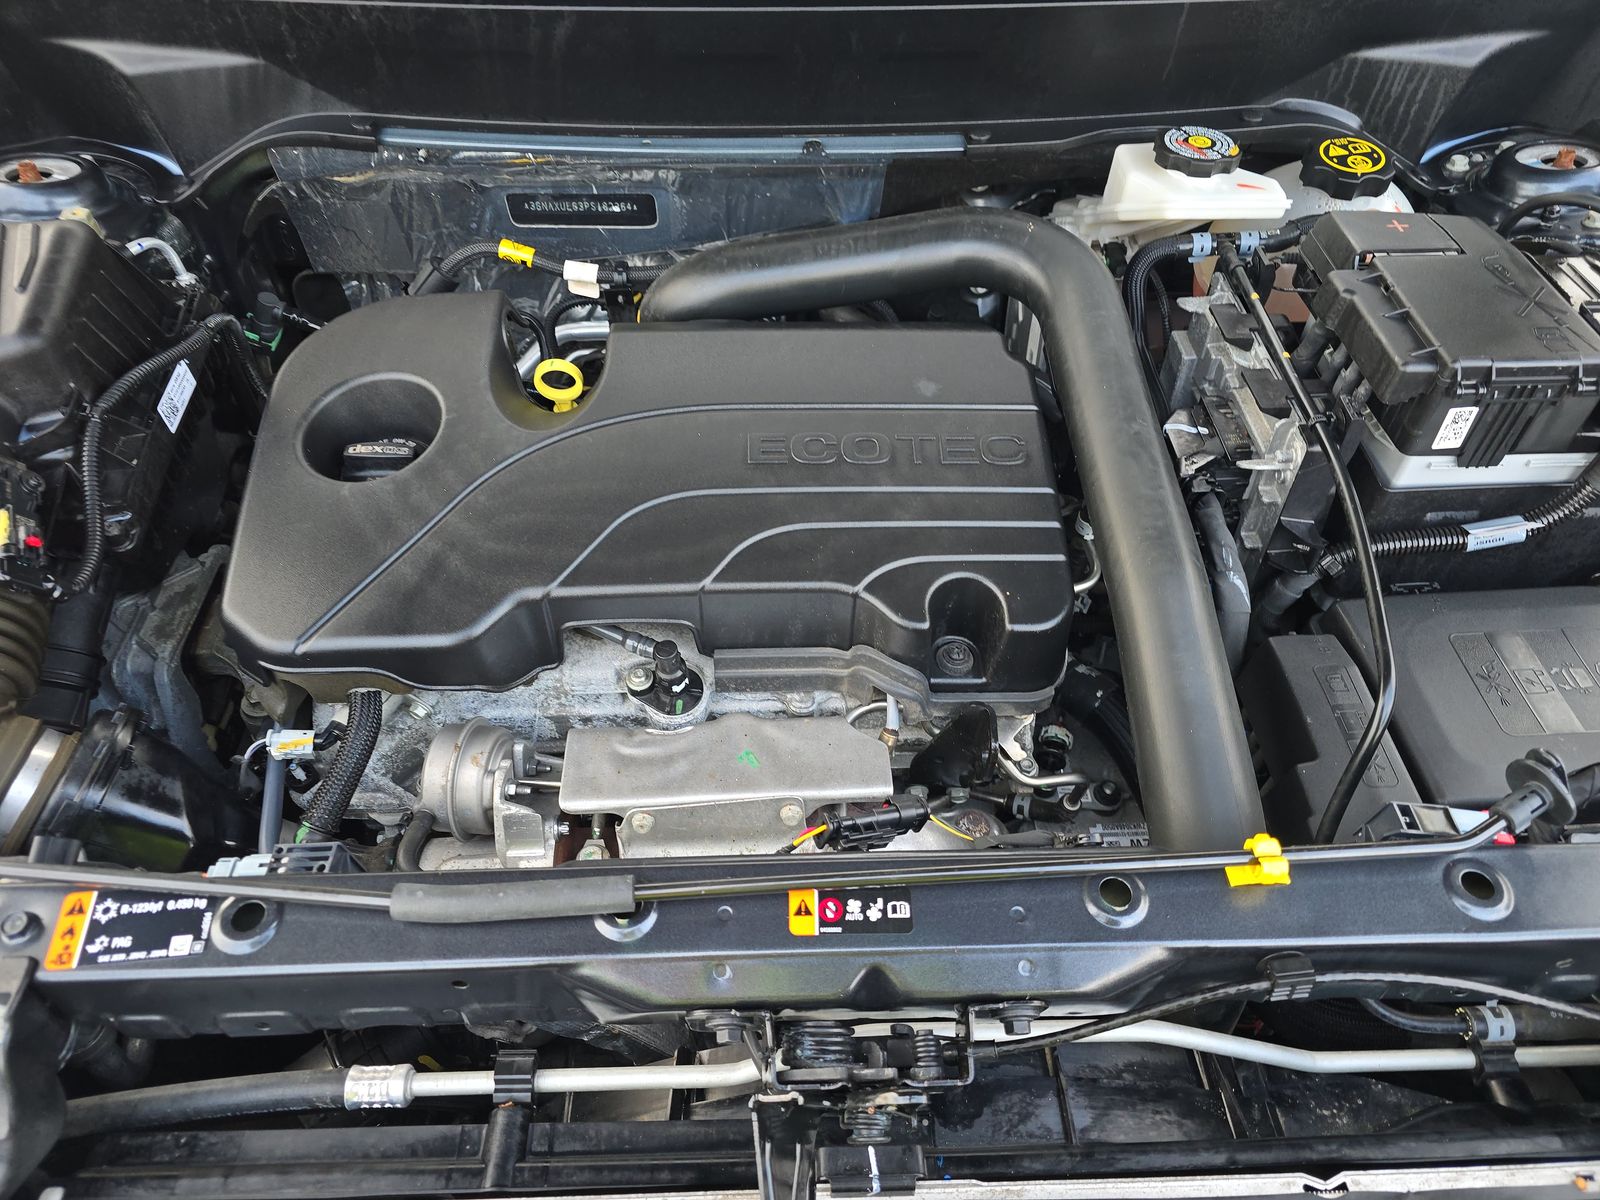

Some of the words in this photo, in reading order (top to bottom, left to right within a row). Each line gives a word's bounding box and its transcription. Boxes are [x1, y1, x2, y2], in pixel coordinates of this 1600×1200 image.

[348, 444, 409, 454] dexos
[747, 433, 1026, 465] ECOTEC
[194, 898, 208, 909] kg
[845, 913, 863, 921] AUTO
[111, 936, 133, 949] PAG
